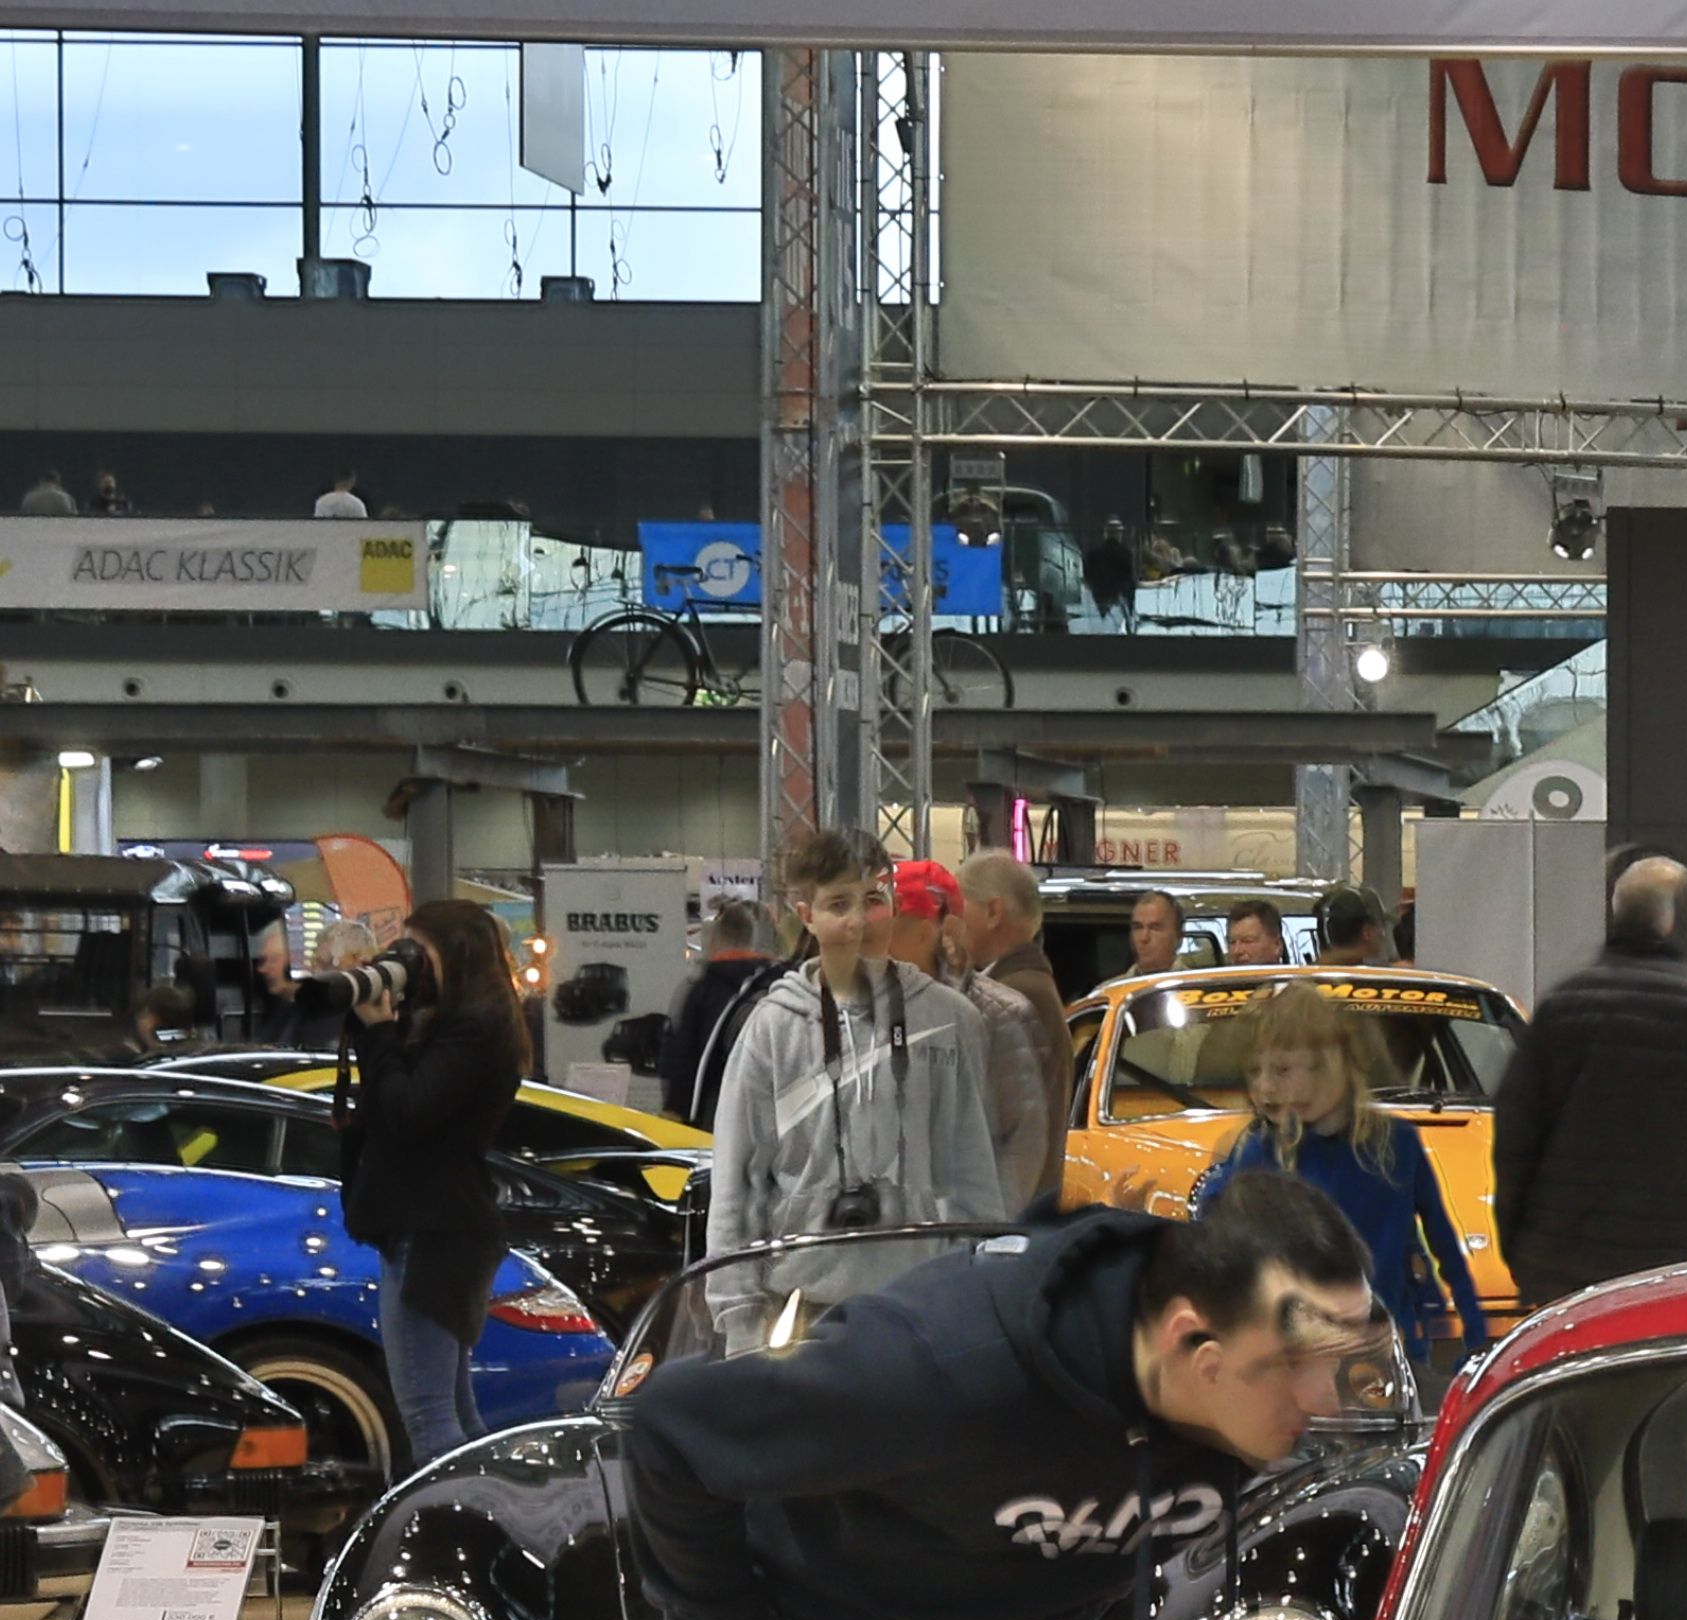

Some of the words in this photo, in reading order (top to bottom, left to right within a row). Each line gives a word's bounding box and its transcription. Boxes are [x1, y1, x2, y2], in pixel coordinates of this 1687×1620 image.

[363, 540, 412, 559] ADAC
[73, 549, 168, 582] ADAC
[176, 549, 307, 582] KLASSIK
[567, 913, 660, 933] BRABUS
[1316, 983, 1448, 1003] MOTOR
